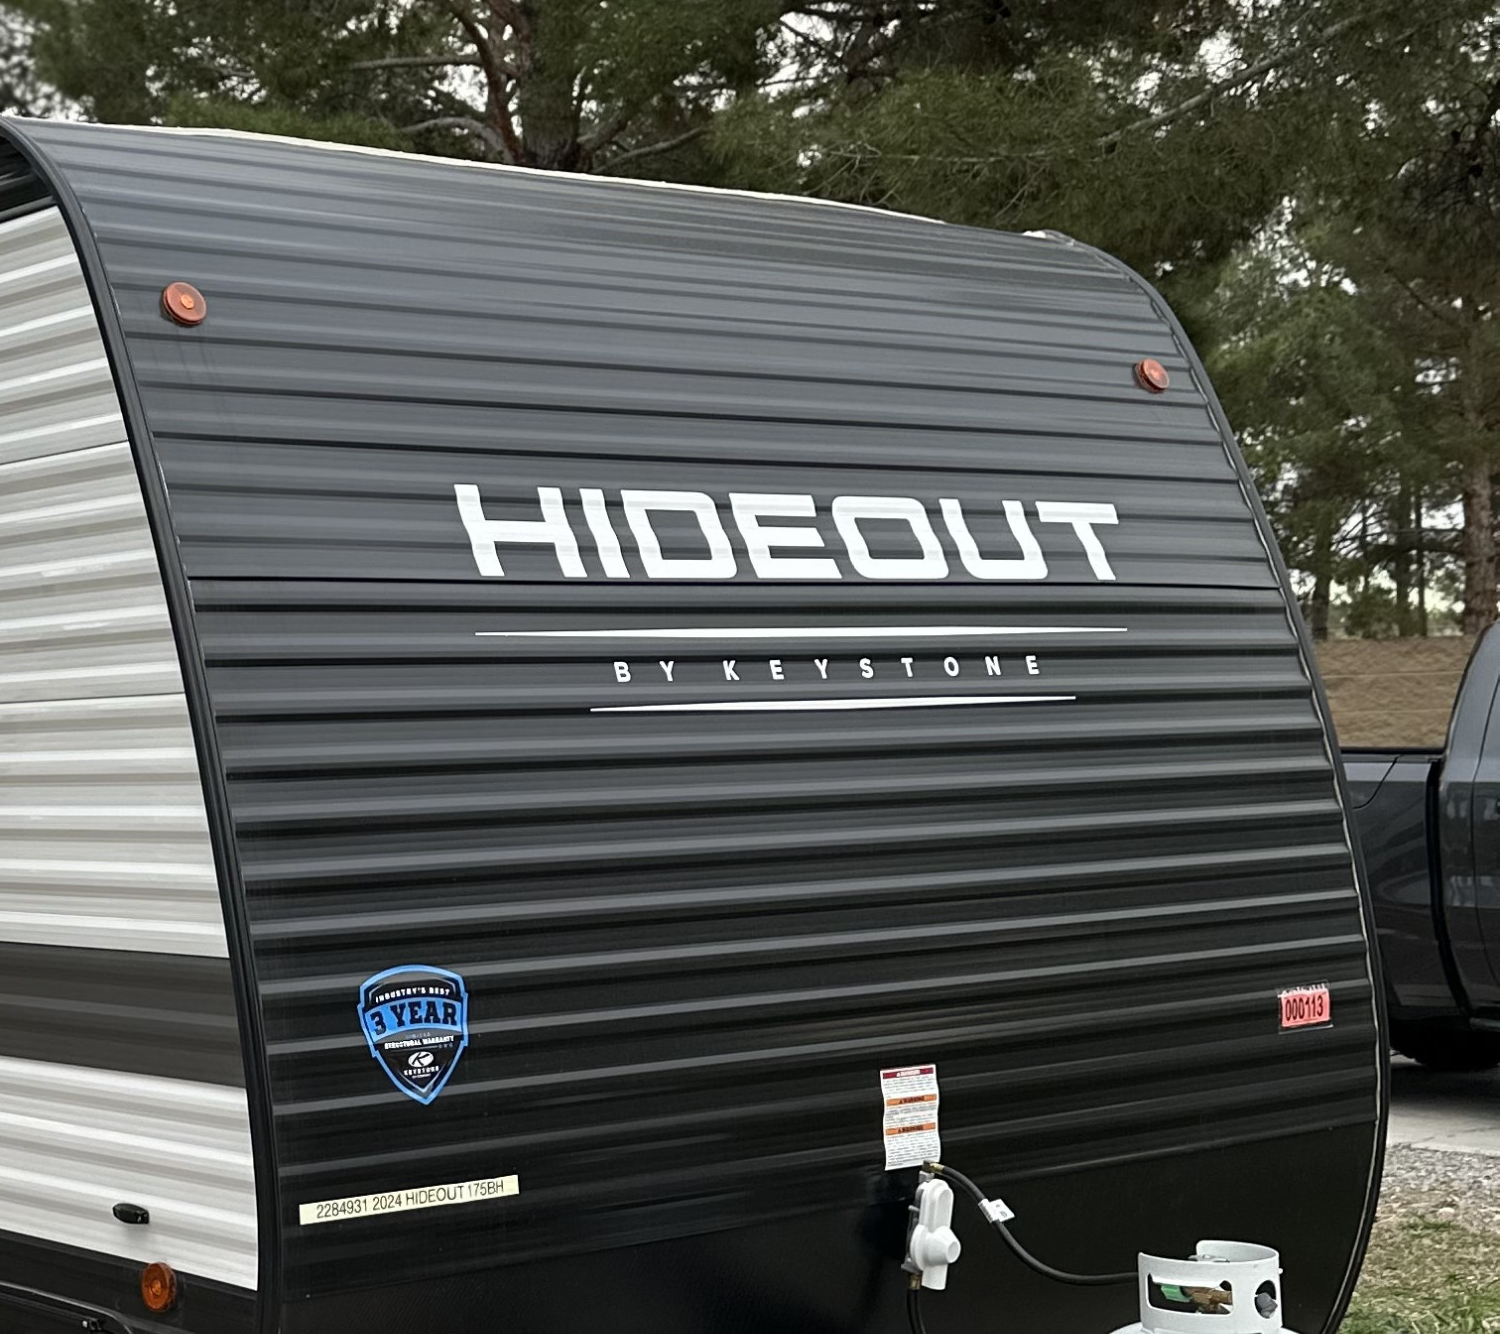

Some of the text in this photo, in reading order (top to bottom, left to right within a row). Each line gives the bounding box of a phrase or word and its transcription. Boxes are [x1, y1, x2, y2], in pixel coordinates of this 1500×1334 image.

[454, 483, 1119, 580] HIDEOUT
[614, 654, 1041, 683] BY KEYSTONE
[370, 1000, 457, 1036] 3 YEAR
[1285, 994, 1324, 1022] 000113
[316, 1180, 504, 1219] 2284931 2024 HIDEOUT 175BH
